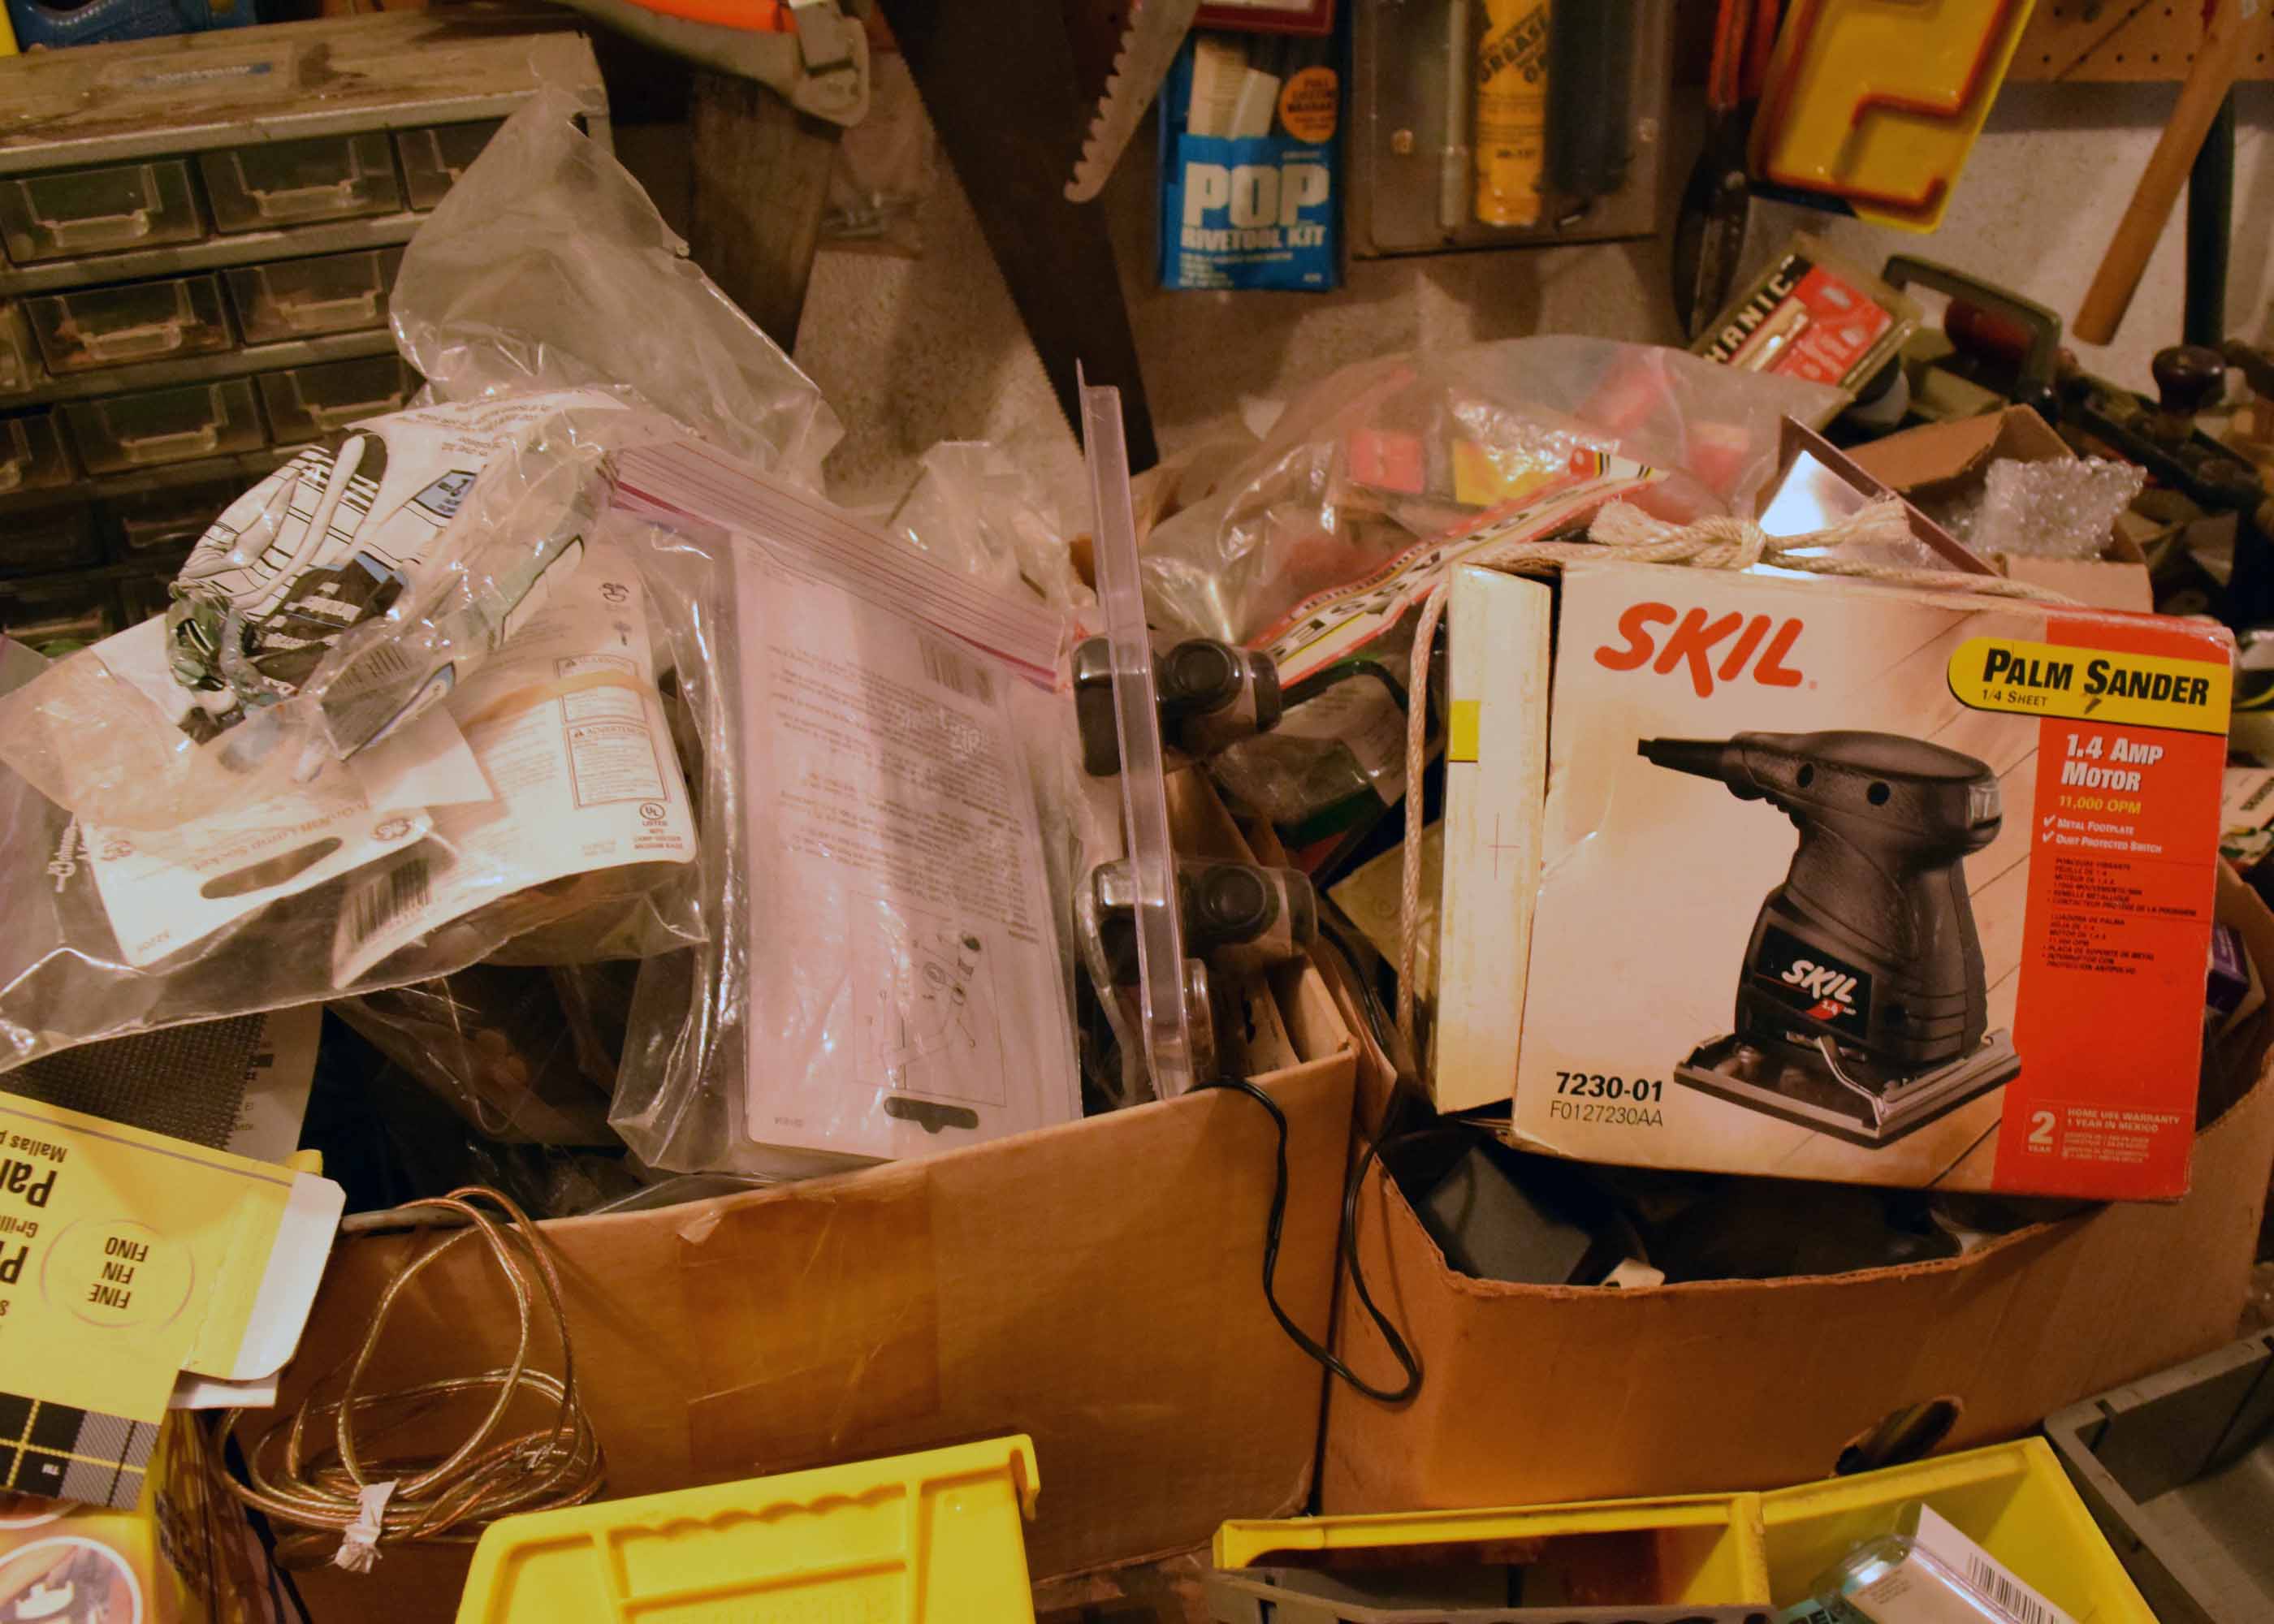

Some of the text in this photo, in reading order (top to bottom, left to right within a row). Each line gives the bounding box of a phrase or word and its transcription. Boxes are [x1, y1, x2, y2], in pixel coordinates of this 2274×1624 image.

[1183, 162, 1330, 229] POP
[1286, 225, 1327, 247] KIT
[1594, 602, 1804, 698] SKIL
[1982, 647, 2210, 706] PALM SANDER
[1982, 689, 2048, 707] 1/4 SHEET
[2067, 733, 2164, 766] 1.4 AMP
[2060, 761, 2142, 793] MOTOR
[2059, 795, 2142, 814] 11,000 OPM
[1781, 960, 1857, 1004] SKIL
[1556, 1072, 1663, 1103] 7230-01
[1550, 1100, 1663, 1127] F0127230AA
[2028, 1110, 2056, 1144] 2
[10, 1135, 68, 1164] Mallas
[105, 1236, 149, 1263] FINO
[102, 1262, 135, 1285] FIN
[89, 1283, 132, 1310] FINE
